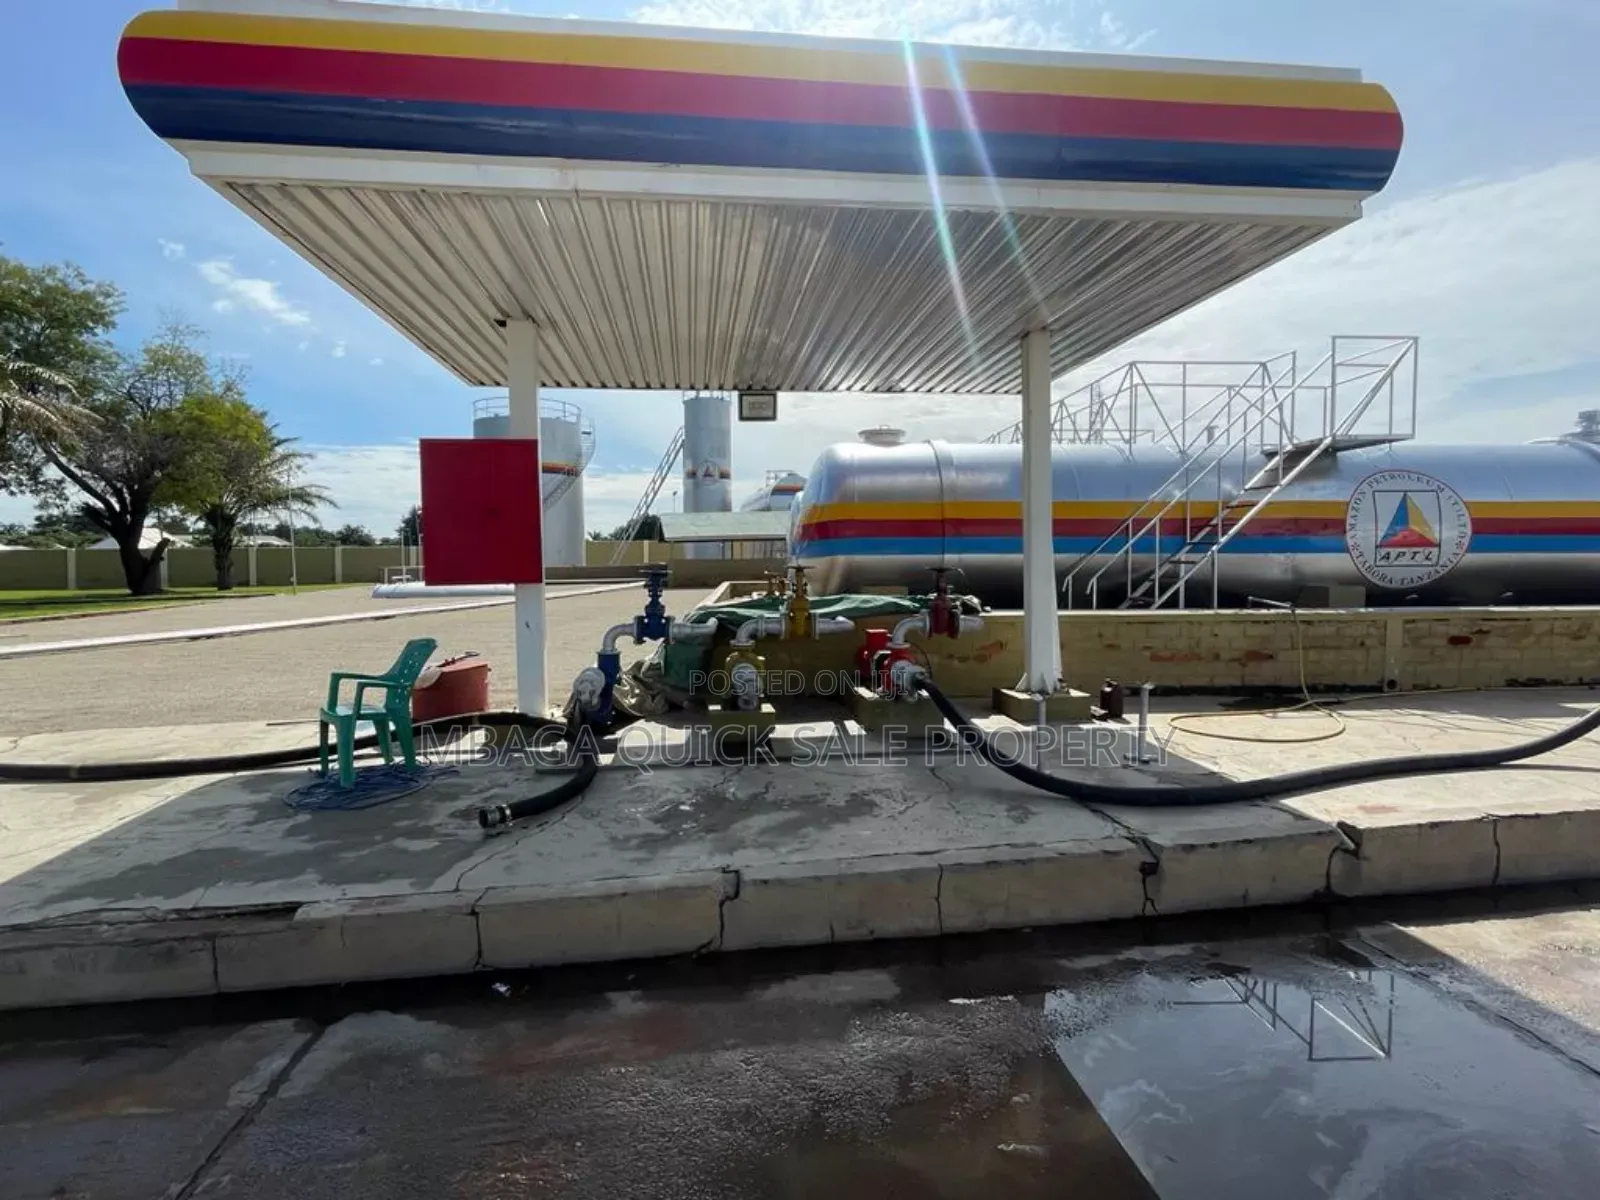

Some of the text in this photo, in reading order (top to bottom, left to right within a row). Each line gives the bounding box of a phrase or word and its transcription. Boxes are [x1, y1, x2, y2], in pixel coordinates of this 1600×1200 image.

[1368, 473, 1446, 495] PETROLEUM
[1379, 550, 1434, 562] APTL
[1356, 551, 1461, 587] TABORA TANZANIA
